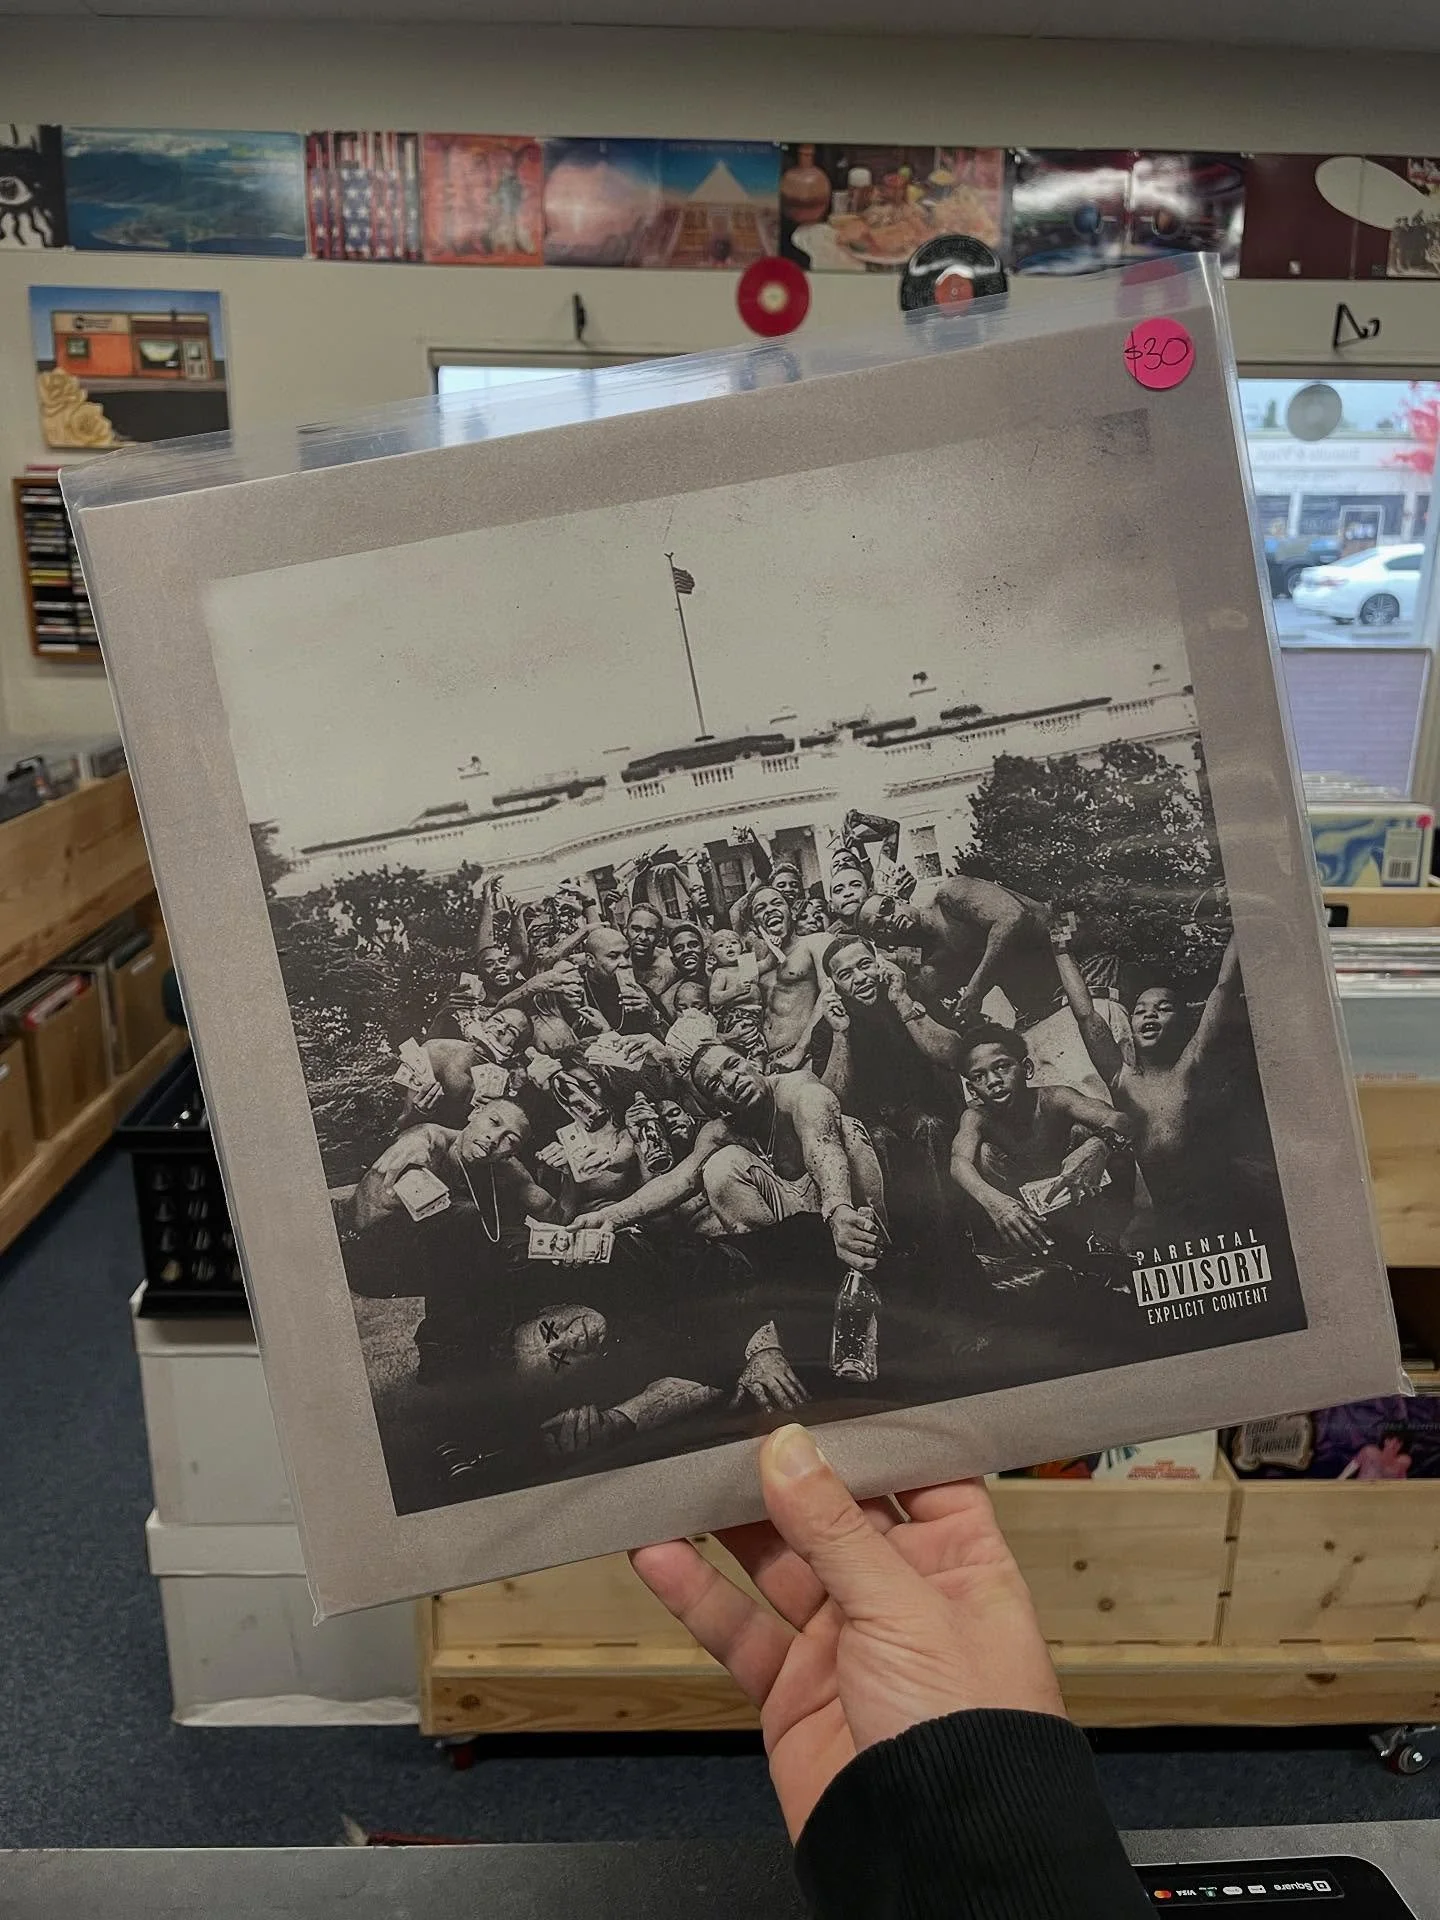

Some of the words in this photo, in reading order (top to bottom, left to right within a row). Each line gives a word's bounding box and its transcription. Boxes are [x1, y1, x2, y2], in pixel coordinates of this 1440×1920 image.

[1123, 329, 1189, 380] $30
[1135, 1228, 1258, 1267] PARENTAL
[1139, 1247, 1265, 1303] ADVISORY
[1146, 1299, 1206, 1326] EXPLICIT
[1211, 1286, 1269, 1313] CONTENT
[1175, 1889, 1197, 1897] VISA
[1273, 1881, 1314, 1892] Square
